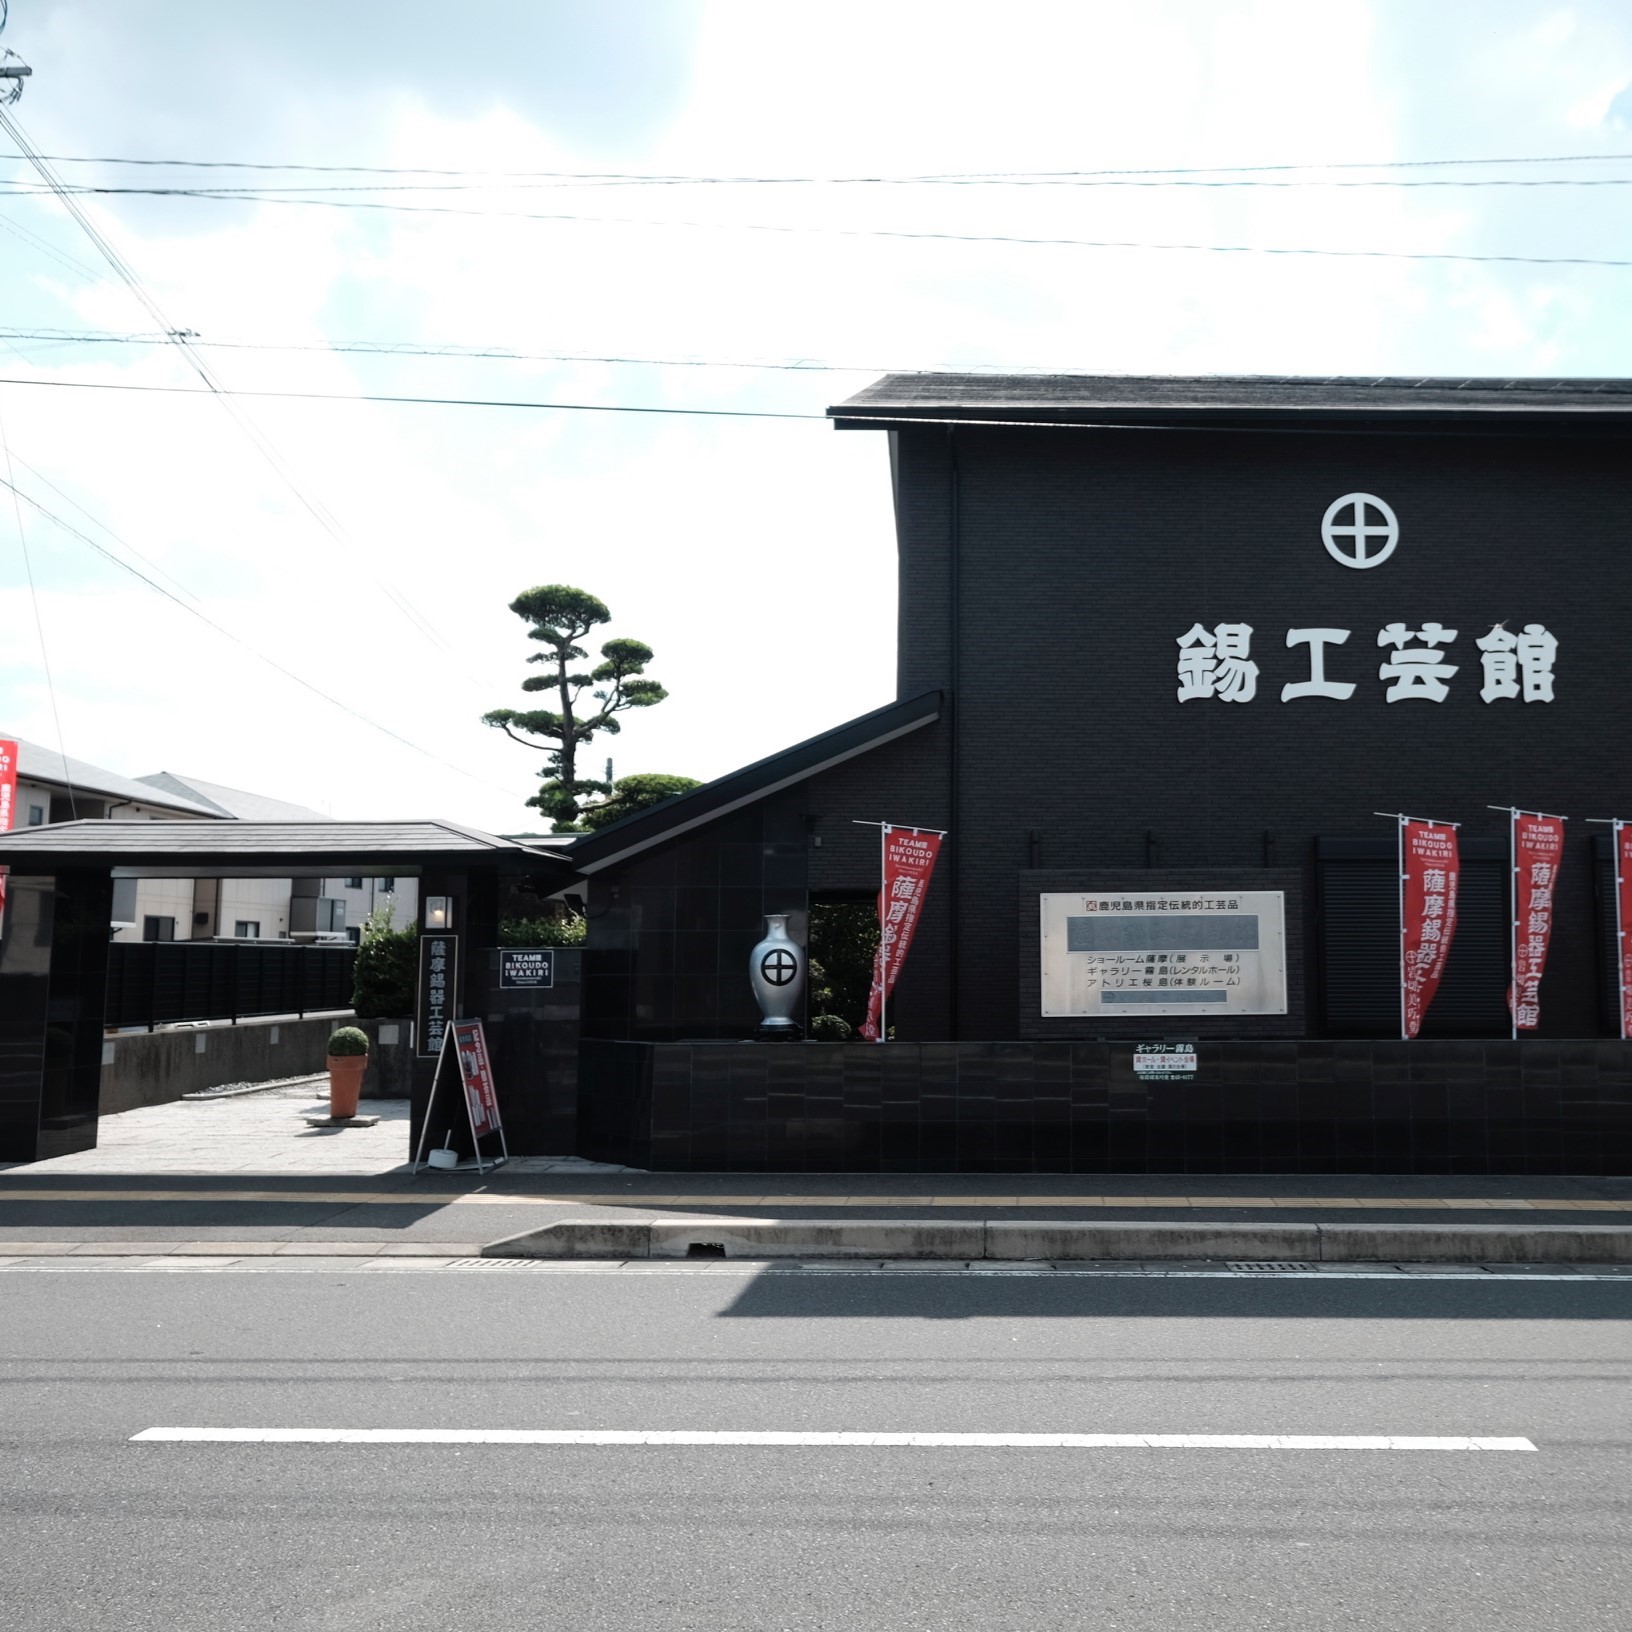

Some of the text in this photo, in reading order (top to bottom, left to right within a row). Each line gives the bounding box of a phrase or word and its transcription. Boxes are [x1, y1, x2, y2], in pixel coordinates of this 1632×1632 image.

[1176, 622, 1559, 704] 錫工芸館
[1521, 832, 1559, 842] BIKOUDO
[1411, 838, 1453, 849] BIKOUDO
[1521, 841, 1558, 851] IWAKIRI
[889, 845, 933, 858] BIKOUDO
[1412, 847, 1452, 858] IWAKIRI
[888, 854, 930, 866] IWAKIRI
[1098, 899, 1239, 911] 鹿児島県指定伝統的工芸品
[505, 961, 549, 969] BIKOUDO
[505, 969, 549, 977] IWAKIRI
[427, 940, 447, 1052] 薩摩錫器工芸館
